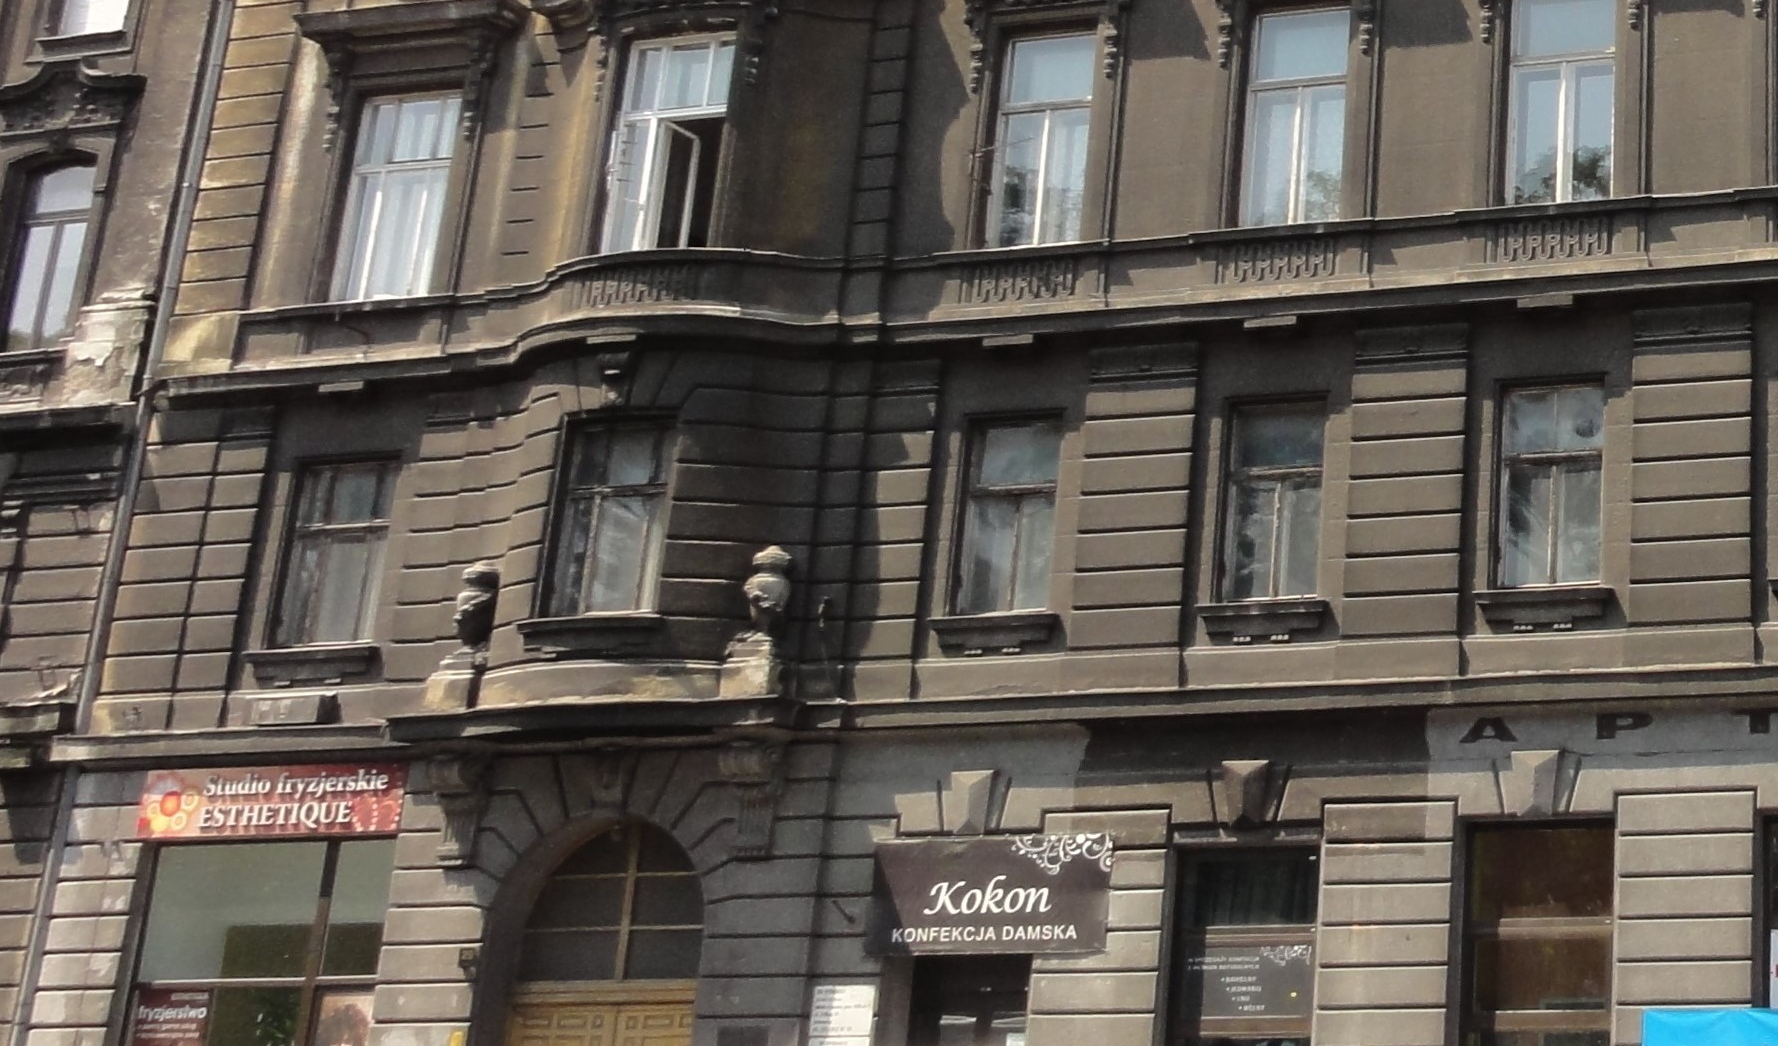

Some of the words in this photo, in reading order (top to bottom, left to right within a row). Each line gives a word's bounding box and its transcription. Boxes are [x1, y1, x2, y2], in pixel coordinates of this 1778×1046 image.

[203, 774, 270, 797] Studio
[275, 769, 389, 799] fryzjerskie
[197, 800, 353, 829] ESTHETIQUE
[923, 874, 1052, 915] Kokon
[891, 926, 997, 943] KONFEKCJA
[1002, 924, 1078, 941] DAMSKA
